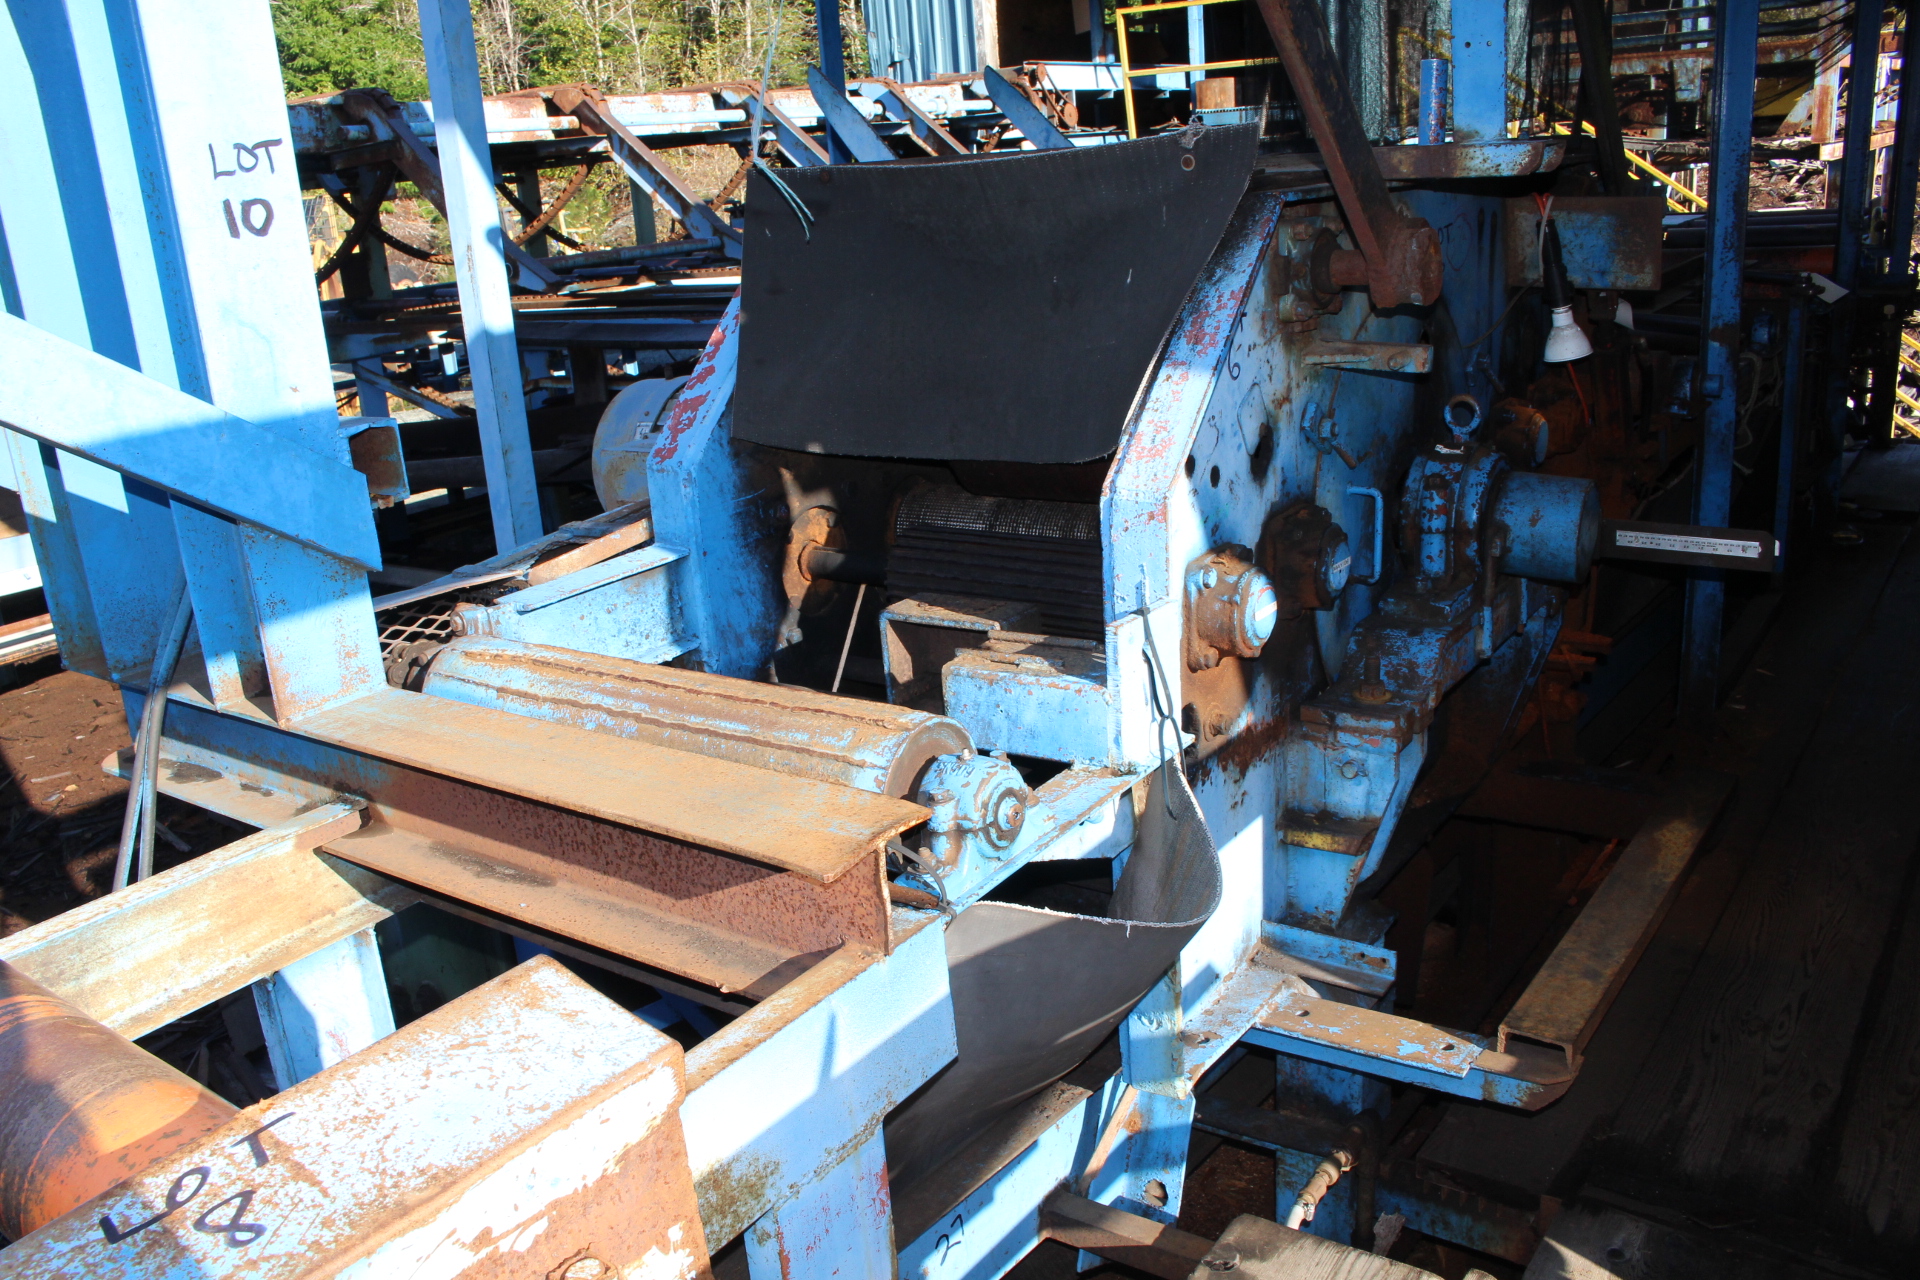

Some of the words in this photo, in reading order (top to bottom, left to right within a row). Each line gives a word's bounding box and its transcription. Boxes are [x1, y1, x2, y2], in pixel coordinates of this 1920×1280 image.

[208, 138, 283, 180] LOT
[222, 198, 275, 239] 10
[99, 1111, 297, 1245] LOT
[193, 1189, 267, 1248] 8
